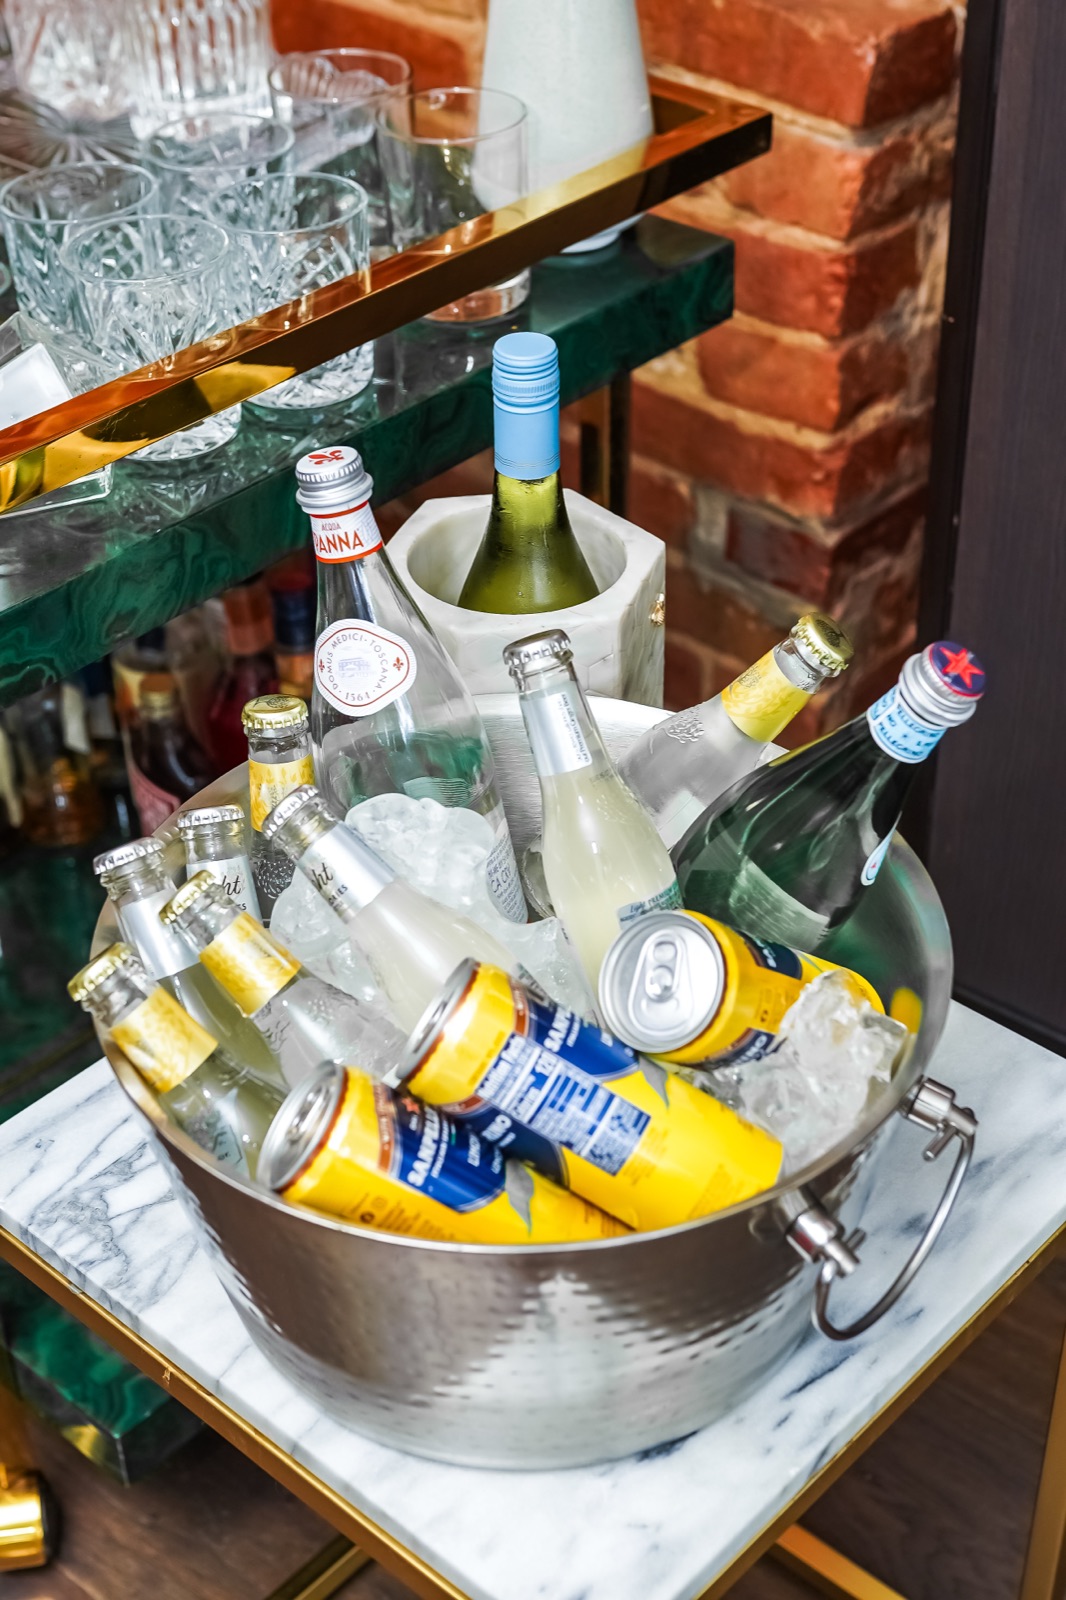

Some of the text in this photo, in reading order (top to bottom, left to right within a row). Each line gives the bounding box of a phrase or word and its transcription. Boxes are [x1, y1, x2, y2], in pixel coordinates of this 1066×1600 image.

[321, 522, 342, 532] ACQUA
[326, 632, 389, 690] DOMUS MEDICI TOSCANA
